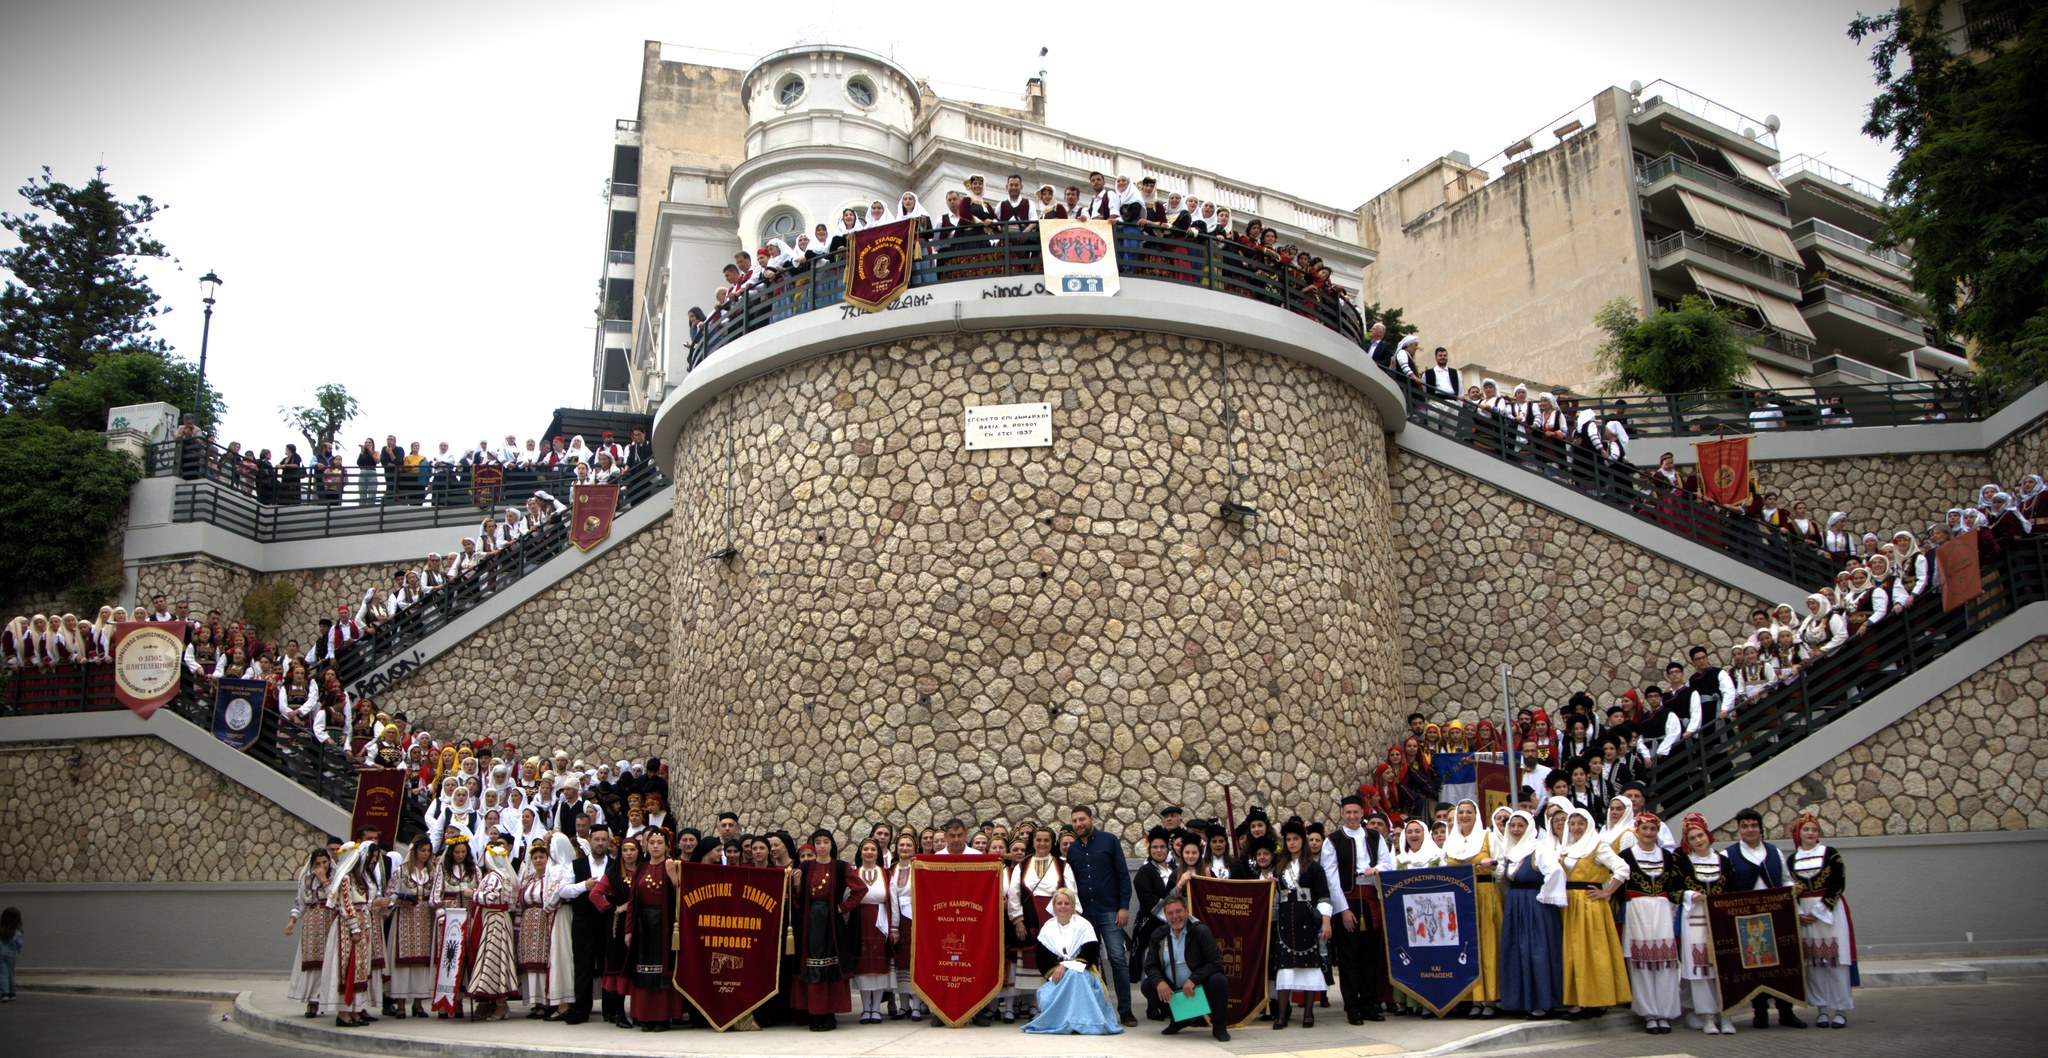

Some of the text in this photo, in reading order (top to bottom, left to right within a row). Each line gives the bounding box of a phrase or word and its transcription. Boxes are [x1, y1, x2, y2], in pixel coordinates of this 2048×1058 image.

[874, 236, 903, 245] ΣΥΛΛΟΓΟΣ
[135, 632, 168, 641] ΠΟΛΙΤΙΣΤΙΚΟΣ
[1403, 874, 1436, 886] ΕΡΓΑΣΤΗΡΙ
[1436, 874, 1473, 894] ΠΟΛΙΤΙΣΜΟΥ
[683, 883, 778, 914] ΠΟΛΙΤΙΣΤΙΚΟΣ ΣΥΛΛΟΓΟΣ
[933, 900, 983, 912] ΣΤΕΓΗ ΚΑΛΑΒΡΥΤΙΝΩΝ
[698, 914, 762, 930] ΑΜΠΕΛΟΚΗΠΩΝ
